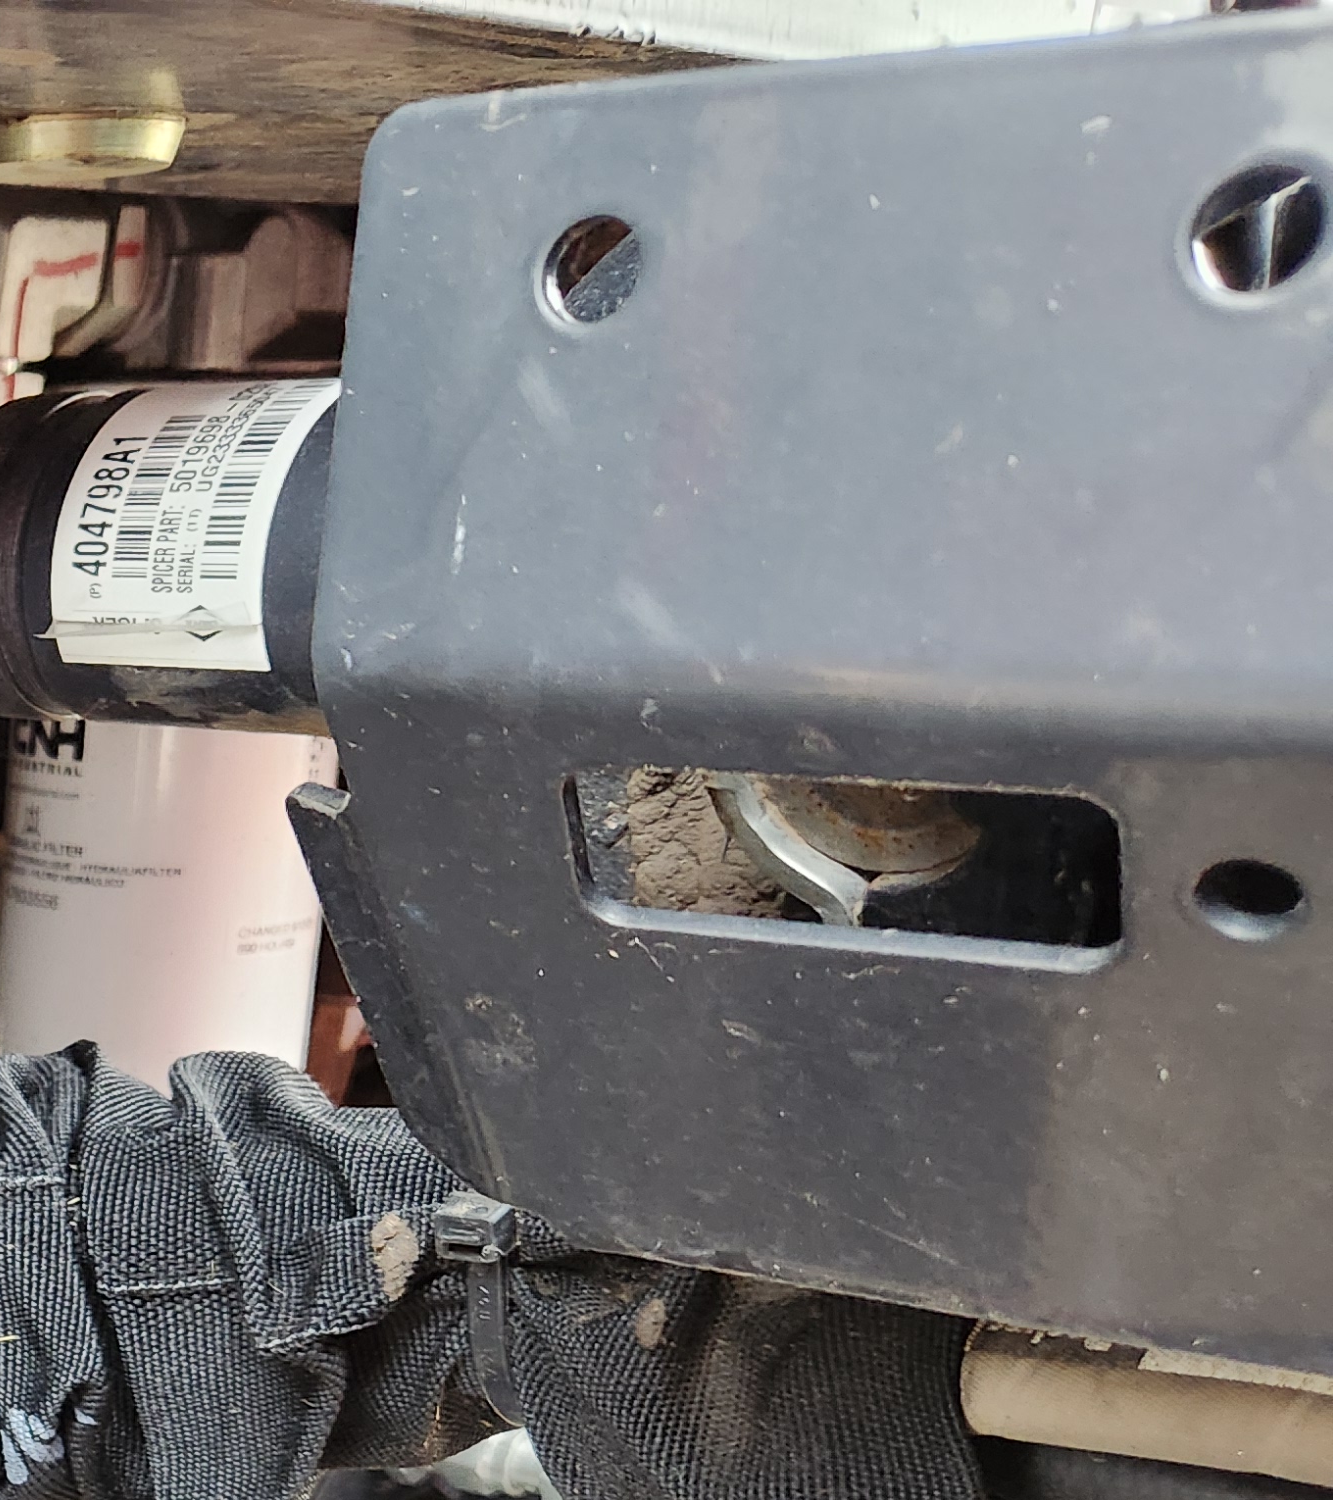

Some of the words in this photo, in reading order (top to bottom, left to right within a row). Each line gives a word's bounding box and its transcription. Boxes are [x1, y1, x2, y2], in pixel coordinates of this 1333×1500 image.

[73, 434, 150, 578] 404798A1
[160, 504, 186, 540] PART:
[151, 534, 174, 594] SPICER
[177, 544, 196, 594] SERIAL:
